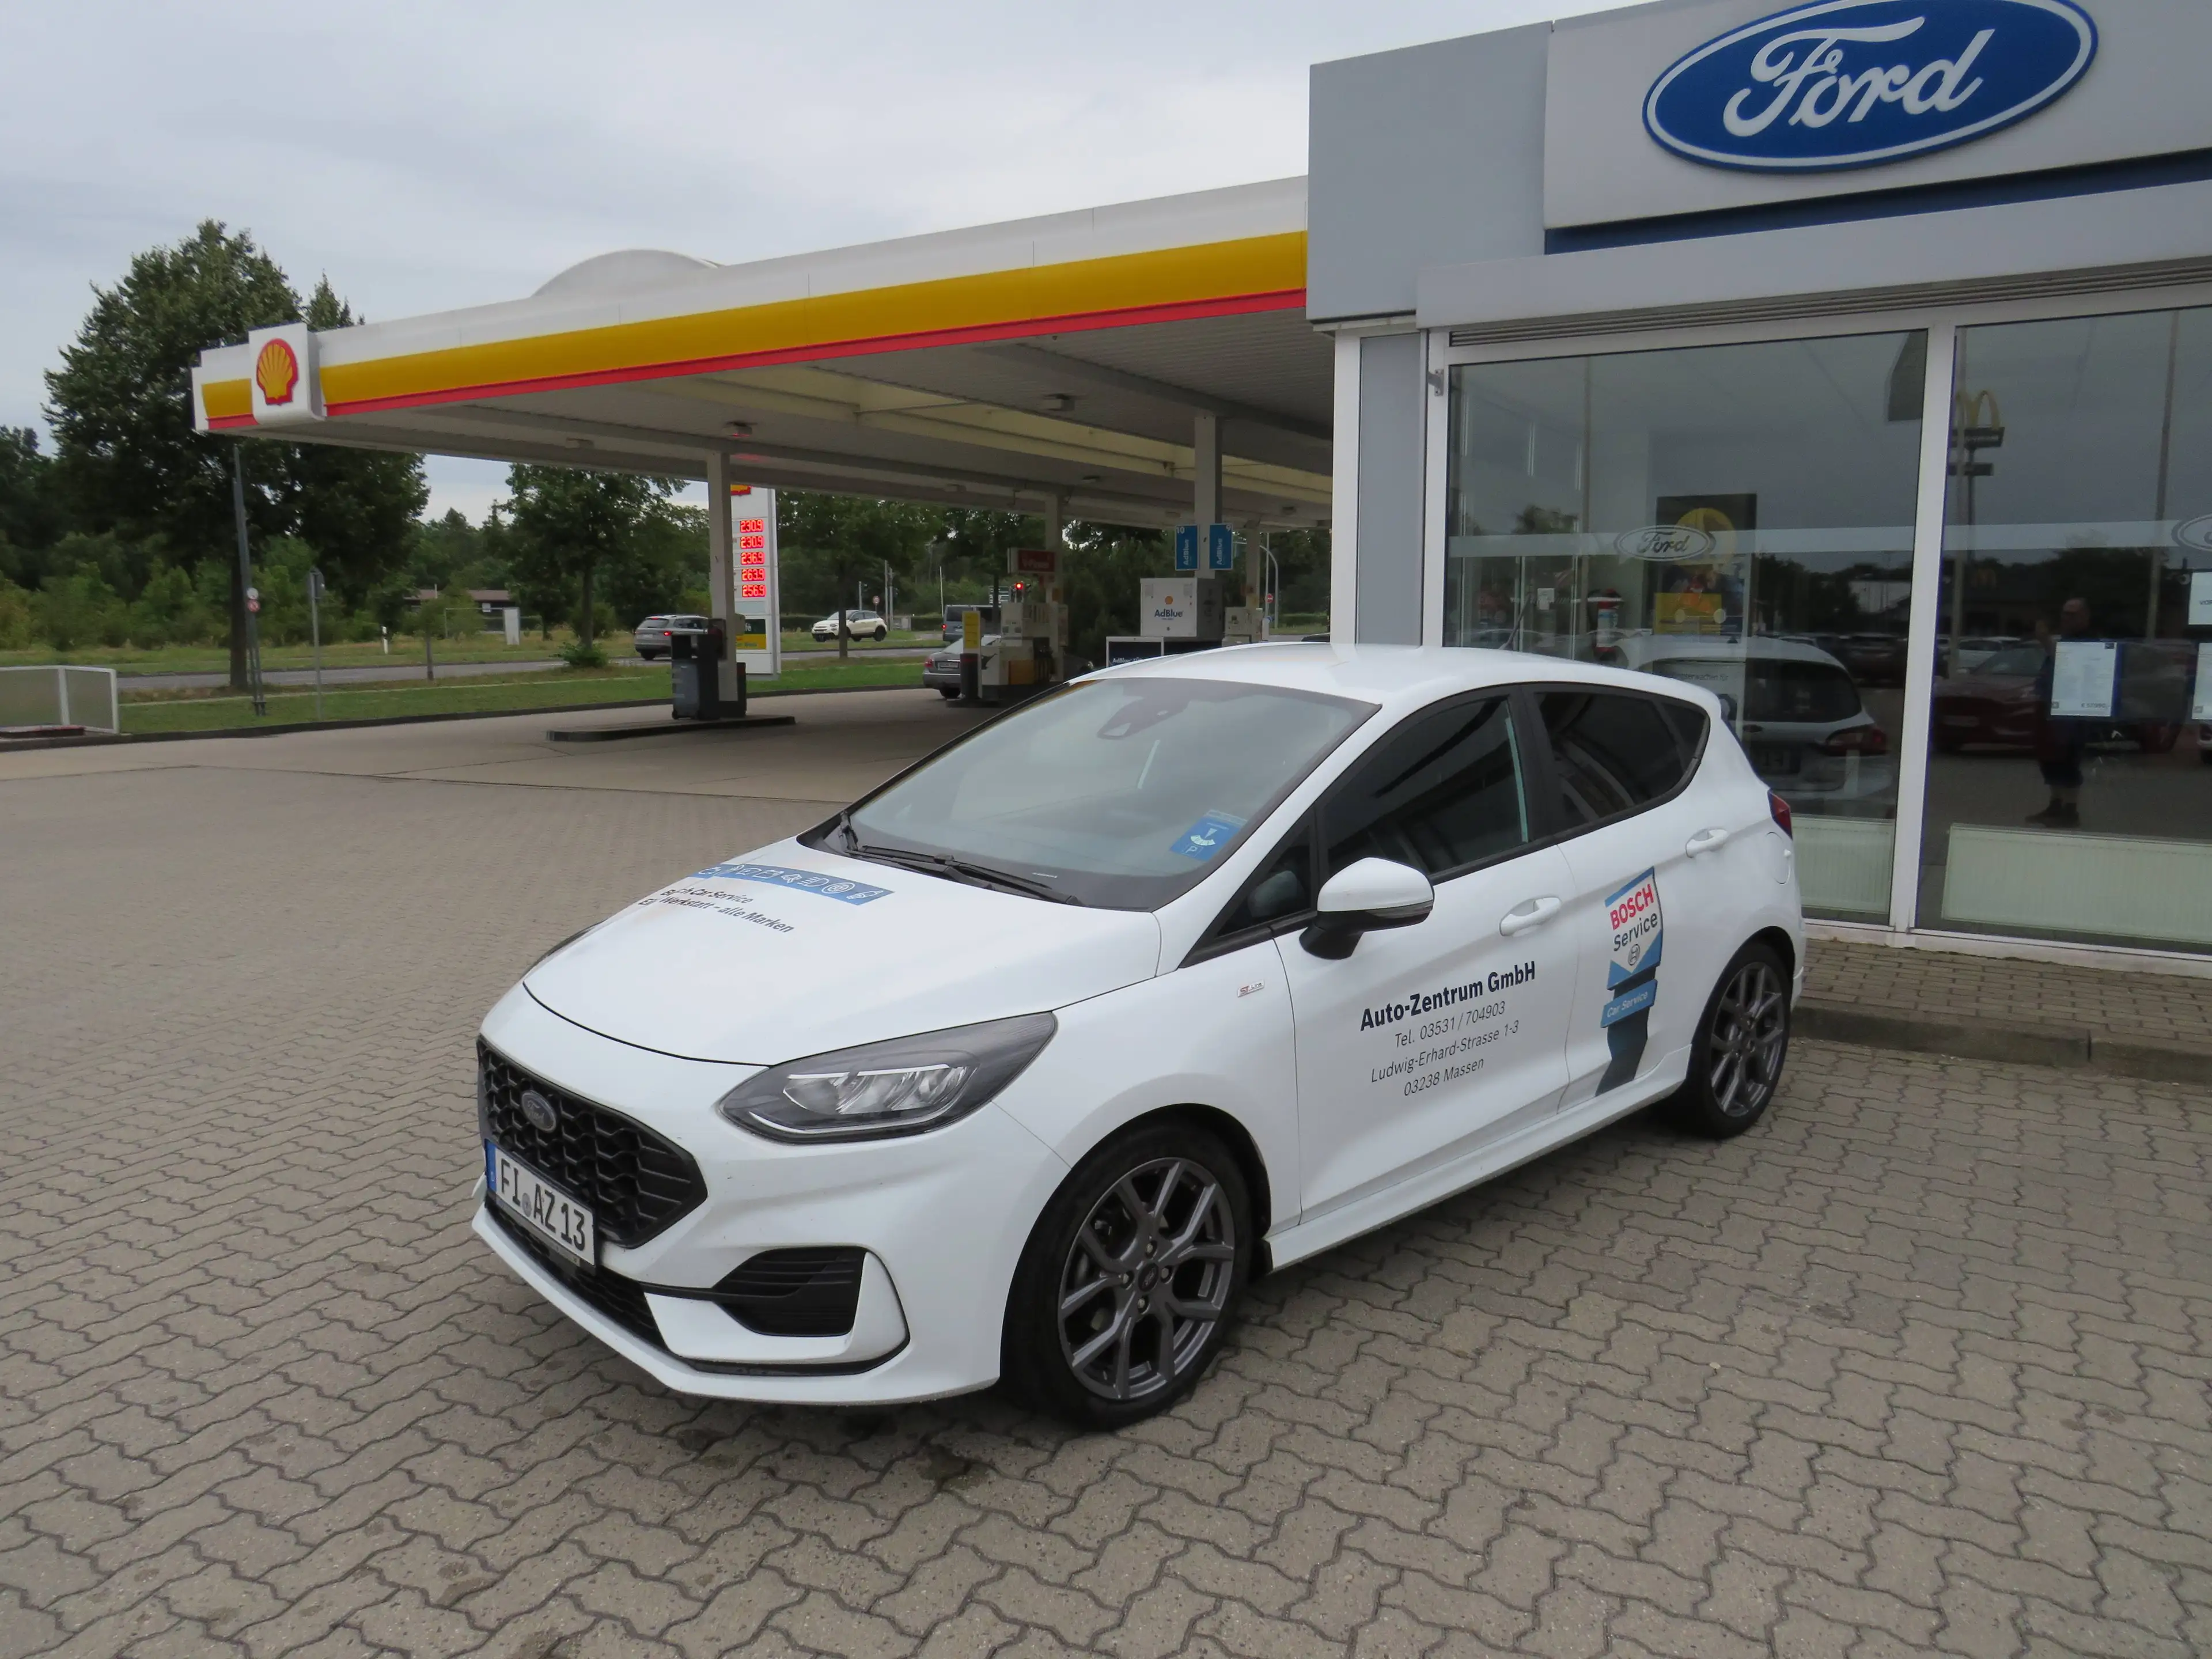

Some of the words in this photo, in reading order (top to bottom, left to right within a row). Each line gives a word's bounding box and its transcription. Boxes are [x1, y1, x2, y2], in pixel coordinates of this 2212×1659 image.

[1723, 16, 1995, 137] Ford
[1637, 531, 1690, 553] Ford
[708, 891, 753, 904] Service
[1610, 884, 1654, 930] BOSCH
[718, 907, 745, 917] alle
[742, 912, 794, 933] Marken
[1613, 912, 1658, 952] Service
[1360, 980, 1483, 1031] Auto-Zentrum
[1488, 961, 1535, 993] GmbH
[1607, 1005, 1621, 1017] Car
[1622, 991, 1648, 1010] Service
[1395, 1029, 1415, 1048] Tel.
[1420, 1016, 1456, 1040] 03531
[1466, 1001, 1505, 1026] 704903
[1371, 1029, 1499, 1083] Ludwig-Erhard-Strasse
[1504, 1020, 1520, 1037] 1-3
[1404, 1072, 1440, 1096] 03238
[1444, 1058, 1484, 1082] Massen
